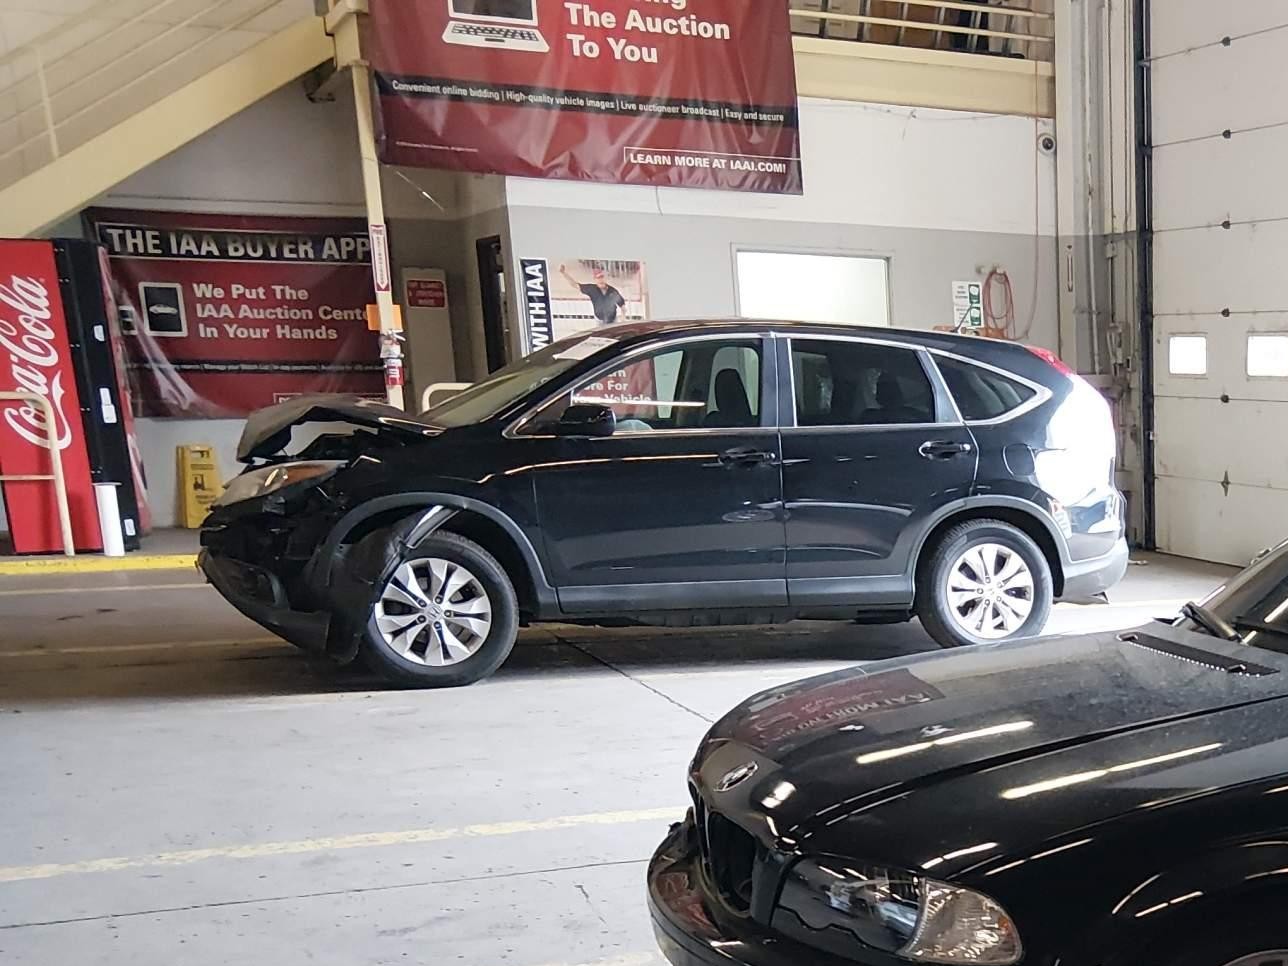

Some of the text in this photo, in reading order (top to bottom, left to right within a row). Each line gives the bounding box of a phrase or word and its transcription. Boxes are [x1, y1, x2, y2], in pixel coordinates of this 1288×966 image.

[564, 2, 730, 39] The Auction
[566, 33, 658, 63] To You
[391, 79, 441, 94] Convenient
[442, 84, 468, 97] online
[469, 87, 500, 100] bidding
[506, 92, 554, 105] High-quality
[555, 96, 585, 106] vehicle
[586, 98, 615, 111] images
[620, 101, 637, 111] Live
[638, 102, 679, 113] auctioneer
[681, 105, 720, 117] broadcast
[725, 108, 742, 121] Easy
[743, 110, 758, 121] and
[758, 112, 785, 122] secure
[630, 152, 787, 174] LEARN MORE AT IAAI.COM!
[106, 228, 162, 254] THE
[169, 231, 220, 256] IAA
[227, 234, 315, 259] BUYER
[322, 237, 369, 260] APP
[192, 283, 309, 300] We Put The
[196, 303, 235, 319] IAA
[238, 304, 313, 320] Auction
[524, 263, 550, 352] WITH IAA
[198, 323, 338, 339] In Your Hands
[607, 380, 628, 391] For
